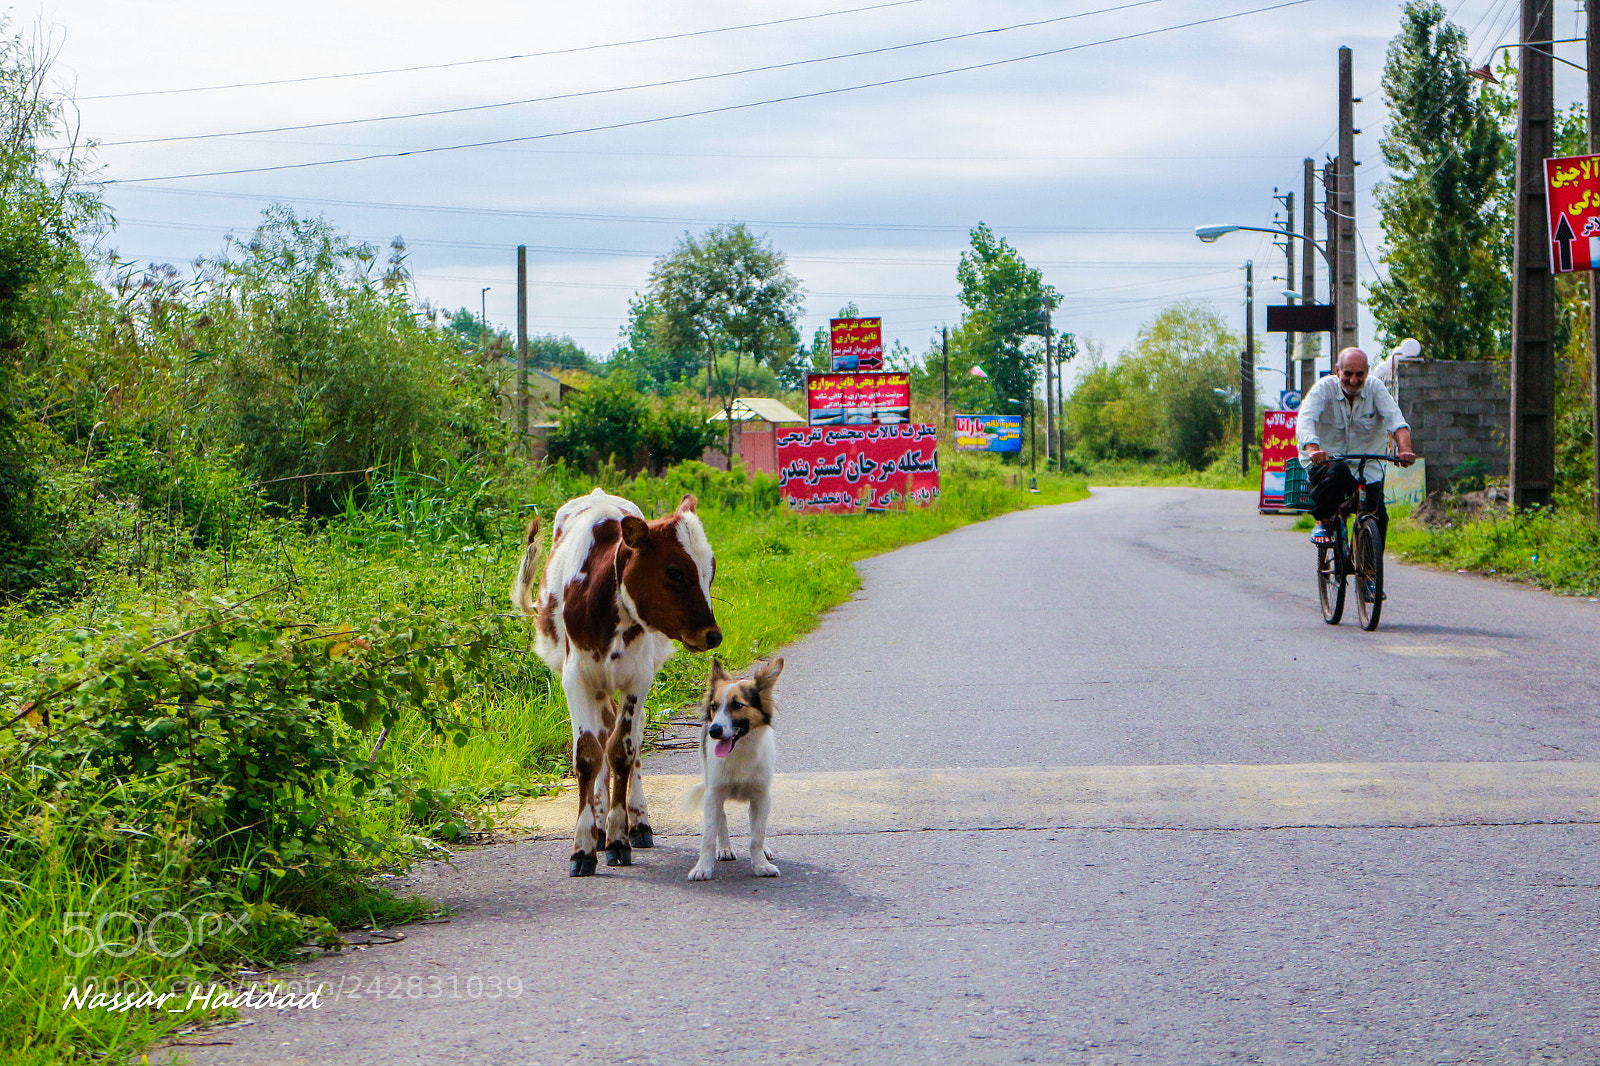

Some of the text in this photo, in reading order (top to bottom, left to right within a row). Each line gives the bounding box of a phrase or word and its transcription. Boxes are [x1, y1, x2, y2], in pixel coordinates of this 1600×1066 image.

[1551, 157, 1600, 188] آلاچیق
[836, 331, 878, 343] قایق سواری
[808, 375, 910, 390] اسکله تفریحی قایق سواری
[1266, 414, 1286, 428] تالاب
[777, 429, 822, 448] تفریحی
[825, 428, 865, 445] مجتمع
[867, 425, 899, 443] تالاب
[1265, 434, 1289, 450] مرجان
[779, 449, 939, 487] اسکله مرجان گستر بندر
[806, 492, 841, 509] تخفیف
[842, 491, 852, 507] با
